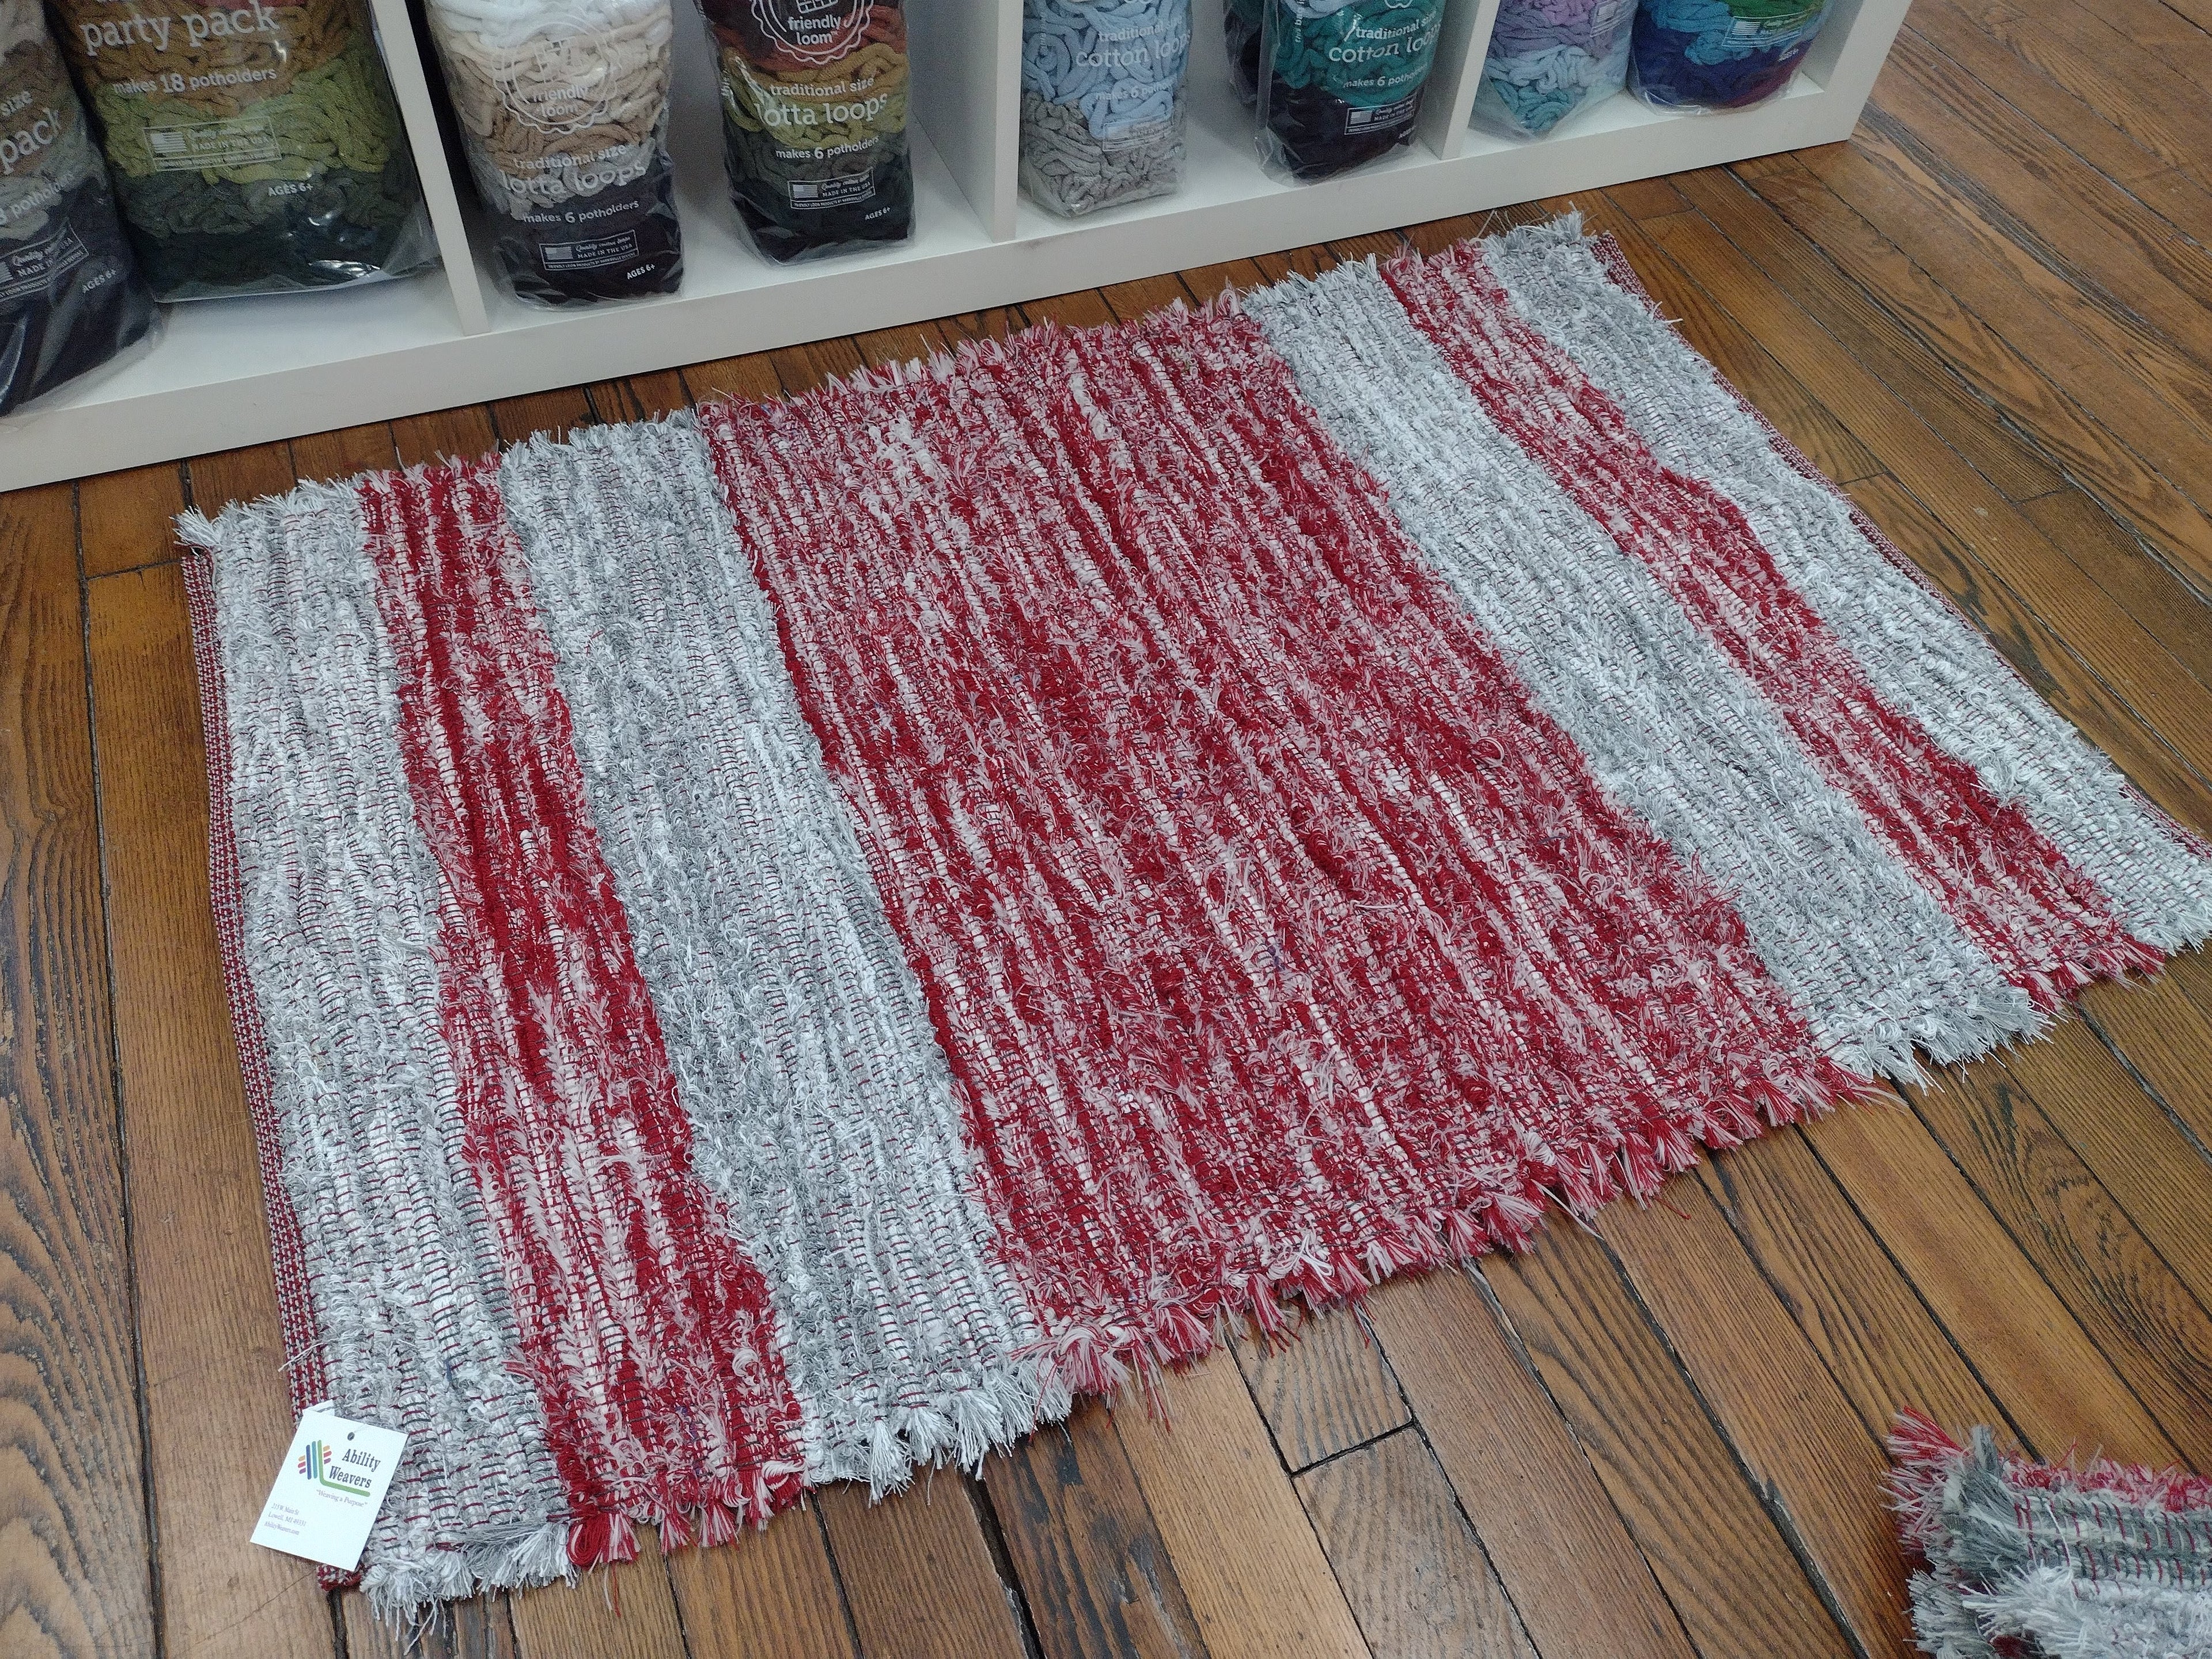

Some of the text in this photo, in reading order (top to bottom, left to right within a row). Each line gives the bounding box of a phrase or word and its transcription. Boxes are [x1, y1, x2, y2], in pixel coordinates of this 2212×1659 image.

[79, 0, 280, 56] party pack
[787, 14, 841, 31] friendly
[1355, 19, 1419, 40] traditional
[1076, 47, 1149, 67] cotton
[1328, 43, 1399, 63] cotton
[159, 73, 185, 93] 18
[189, 68, 278, 90] potholders
[770, 77, 874, 97] traditional size
[1377, 75, 1386, 86] 6
[754, 92, 888, 127] lotta loops
[598, 144, 627, 160] size
[775, 135, 880, 160] makes 6 potholders
[499, 160, 646, 195] lotta loops
[267, 181, 315, 197] AGES 6+
[522, 199, 639, 224] makes 6 potholders
[865, 209, 882, 221] AGES
[626, 263, 656, 279] AGES 6+
[342, 1448, 381, 1472] Ability
[329, 1465, 372, 1488] Weavers
